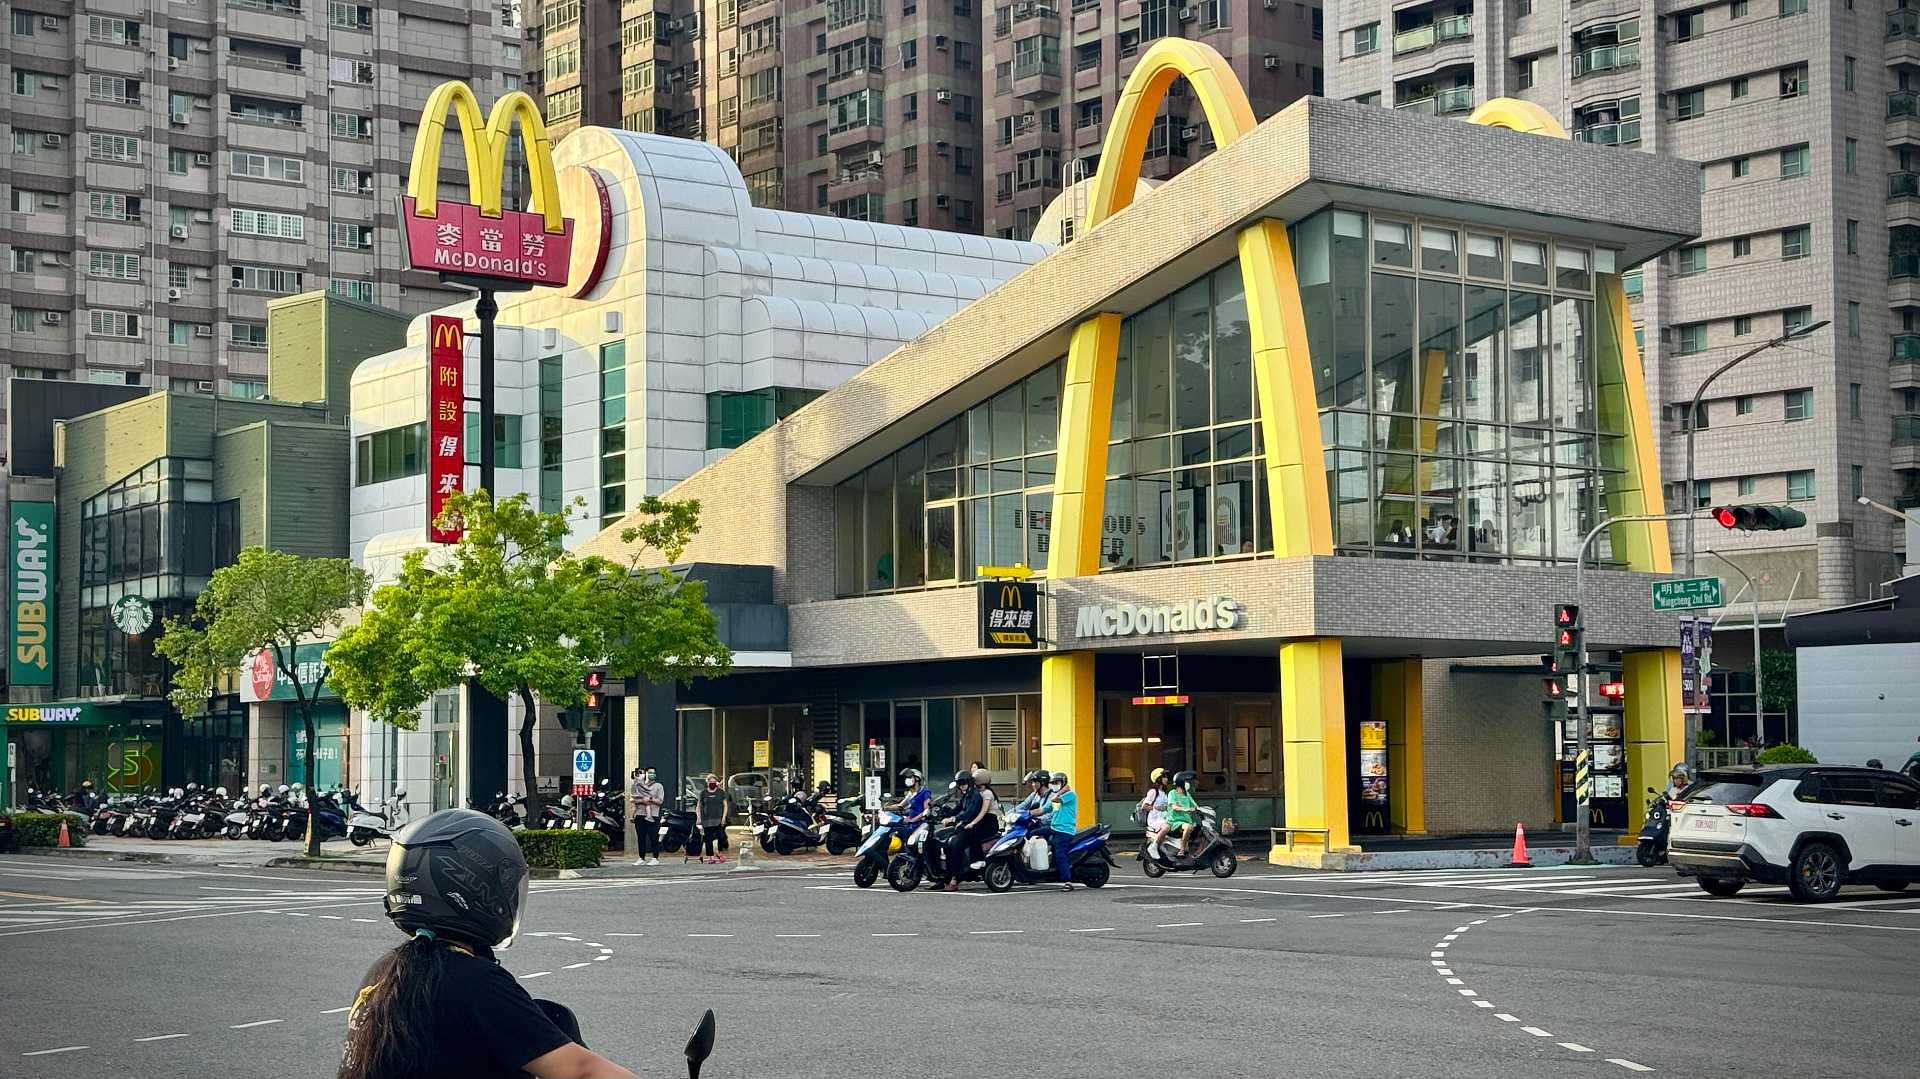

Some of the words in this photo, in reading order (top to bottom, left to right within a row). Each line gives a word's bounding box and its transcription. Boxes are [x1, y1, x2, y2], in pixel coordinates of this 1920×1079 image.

[436, 223, 546, 257] 麥當勞
[434, 248, 547, 277] McDonald's
[436, 366, 461, 532] 附設得來
[15, 516, 49, 671] SUBWAY
[1692, 593, 1703, 604] 2nd
[989, 608, 1034, 628] 得來速
[1075, 595, 1239, 638] McDonald's
[8, 706, 82, 722] SUBWAY
